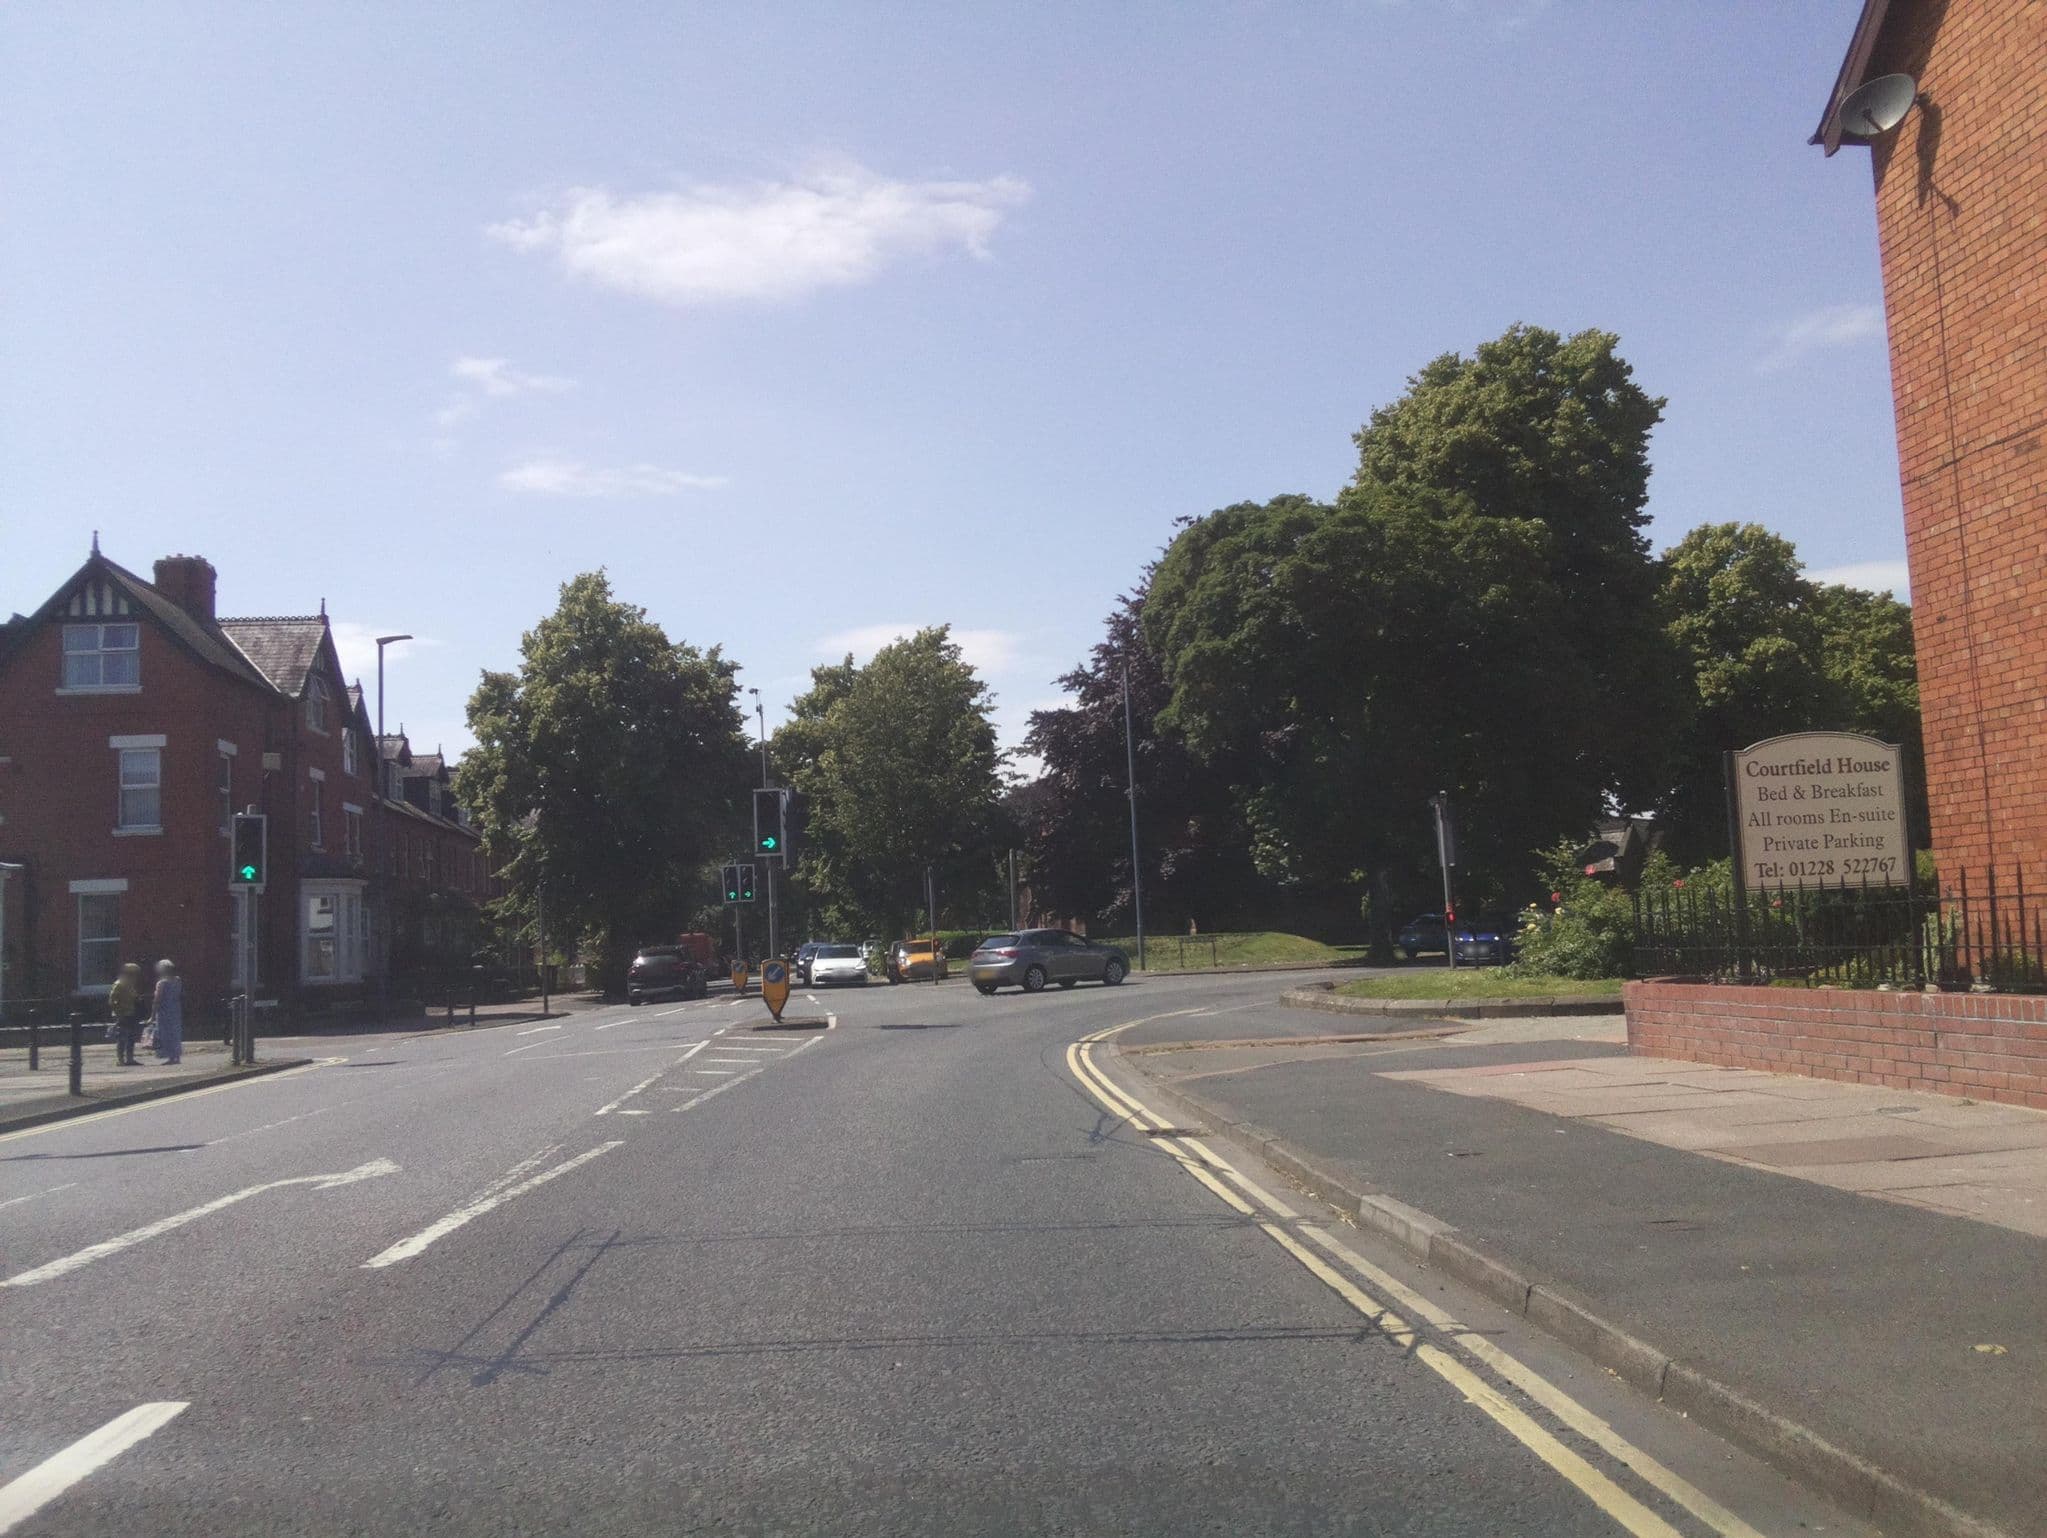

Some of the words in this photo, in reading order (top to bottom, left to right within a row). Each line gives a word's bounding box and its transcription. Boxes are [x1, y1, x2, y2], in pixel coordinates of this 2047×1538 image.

[1746, 758, 1832, 778] Courtfield
[1837, 757, 1891, 773] House
[1758, 786, 1787, 802] Bed
[1793, 785, 1807, 801] &
[1812, 782, 1884, 800] Breakfast
[1748, 811, 1771, 827] All
[1777, 812, 1825, 826] rooms
[1829, 806, 1896, 824] En-suite
[1763, 836, 1819, 851] Private
[1823, 833, 1885, 850] Parking
[1754, 862, 1784, 879] Tel:
[1789, 860, 1835, 877] 01228
[1843, 857, 1897, 874] 522767
